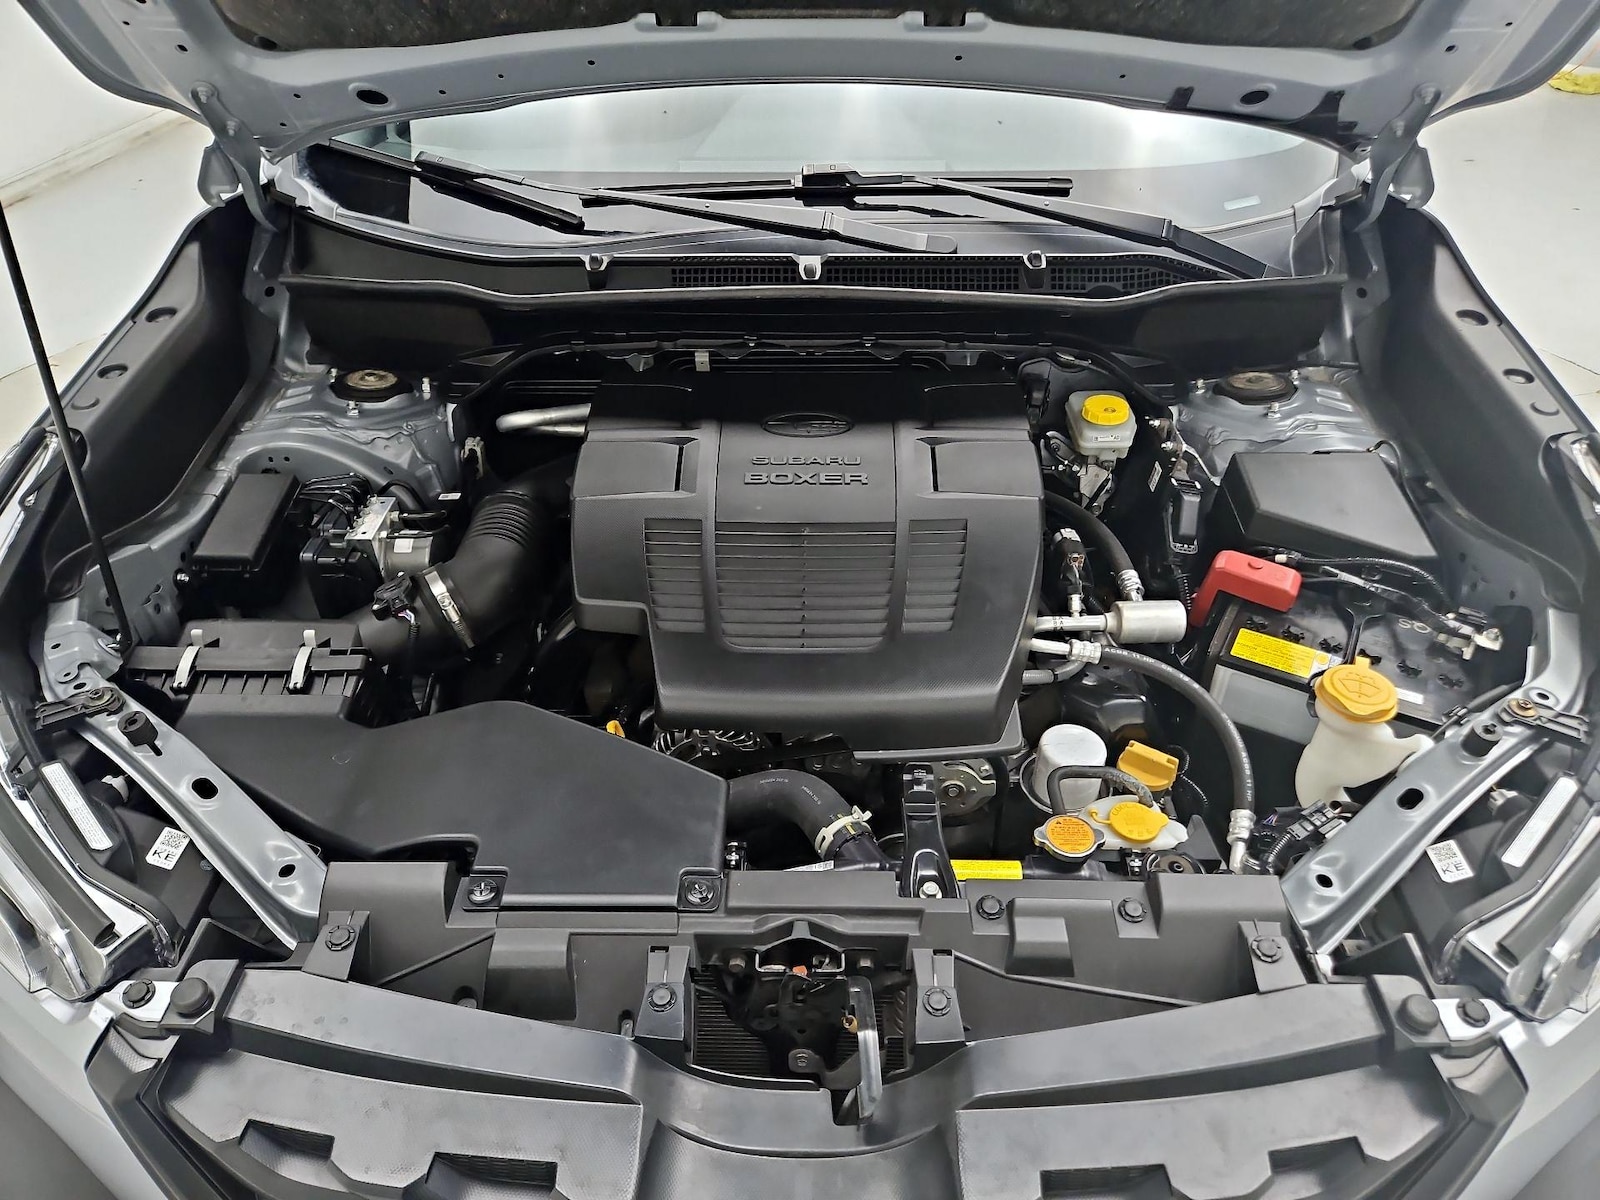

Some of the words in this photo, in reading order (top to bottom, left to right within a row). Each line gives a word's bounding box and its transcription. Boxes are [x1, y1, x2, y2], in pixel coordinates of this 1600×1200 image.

[751, 455, 861, 466] SUBARU
[744, 472, 869, 485] BOXER
[152, 849, 176, 862] KE
[1441, 861, 1465, 875] KE
